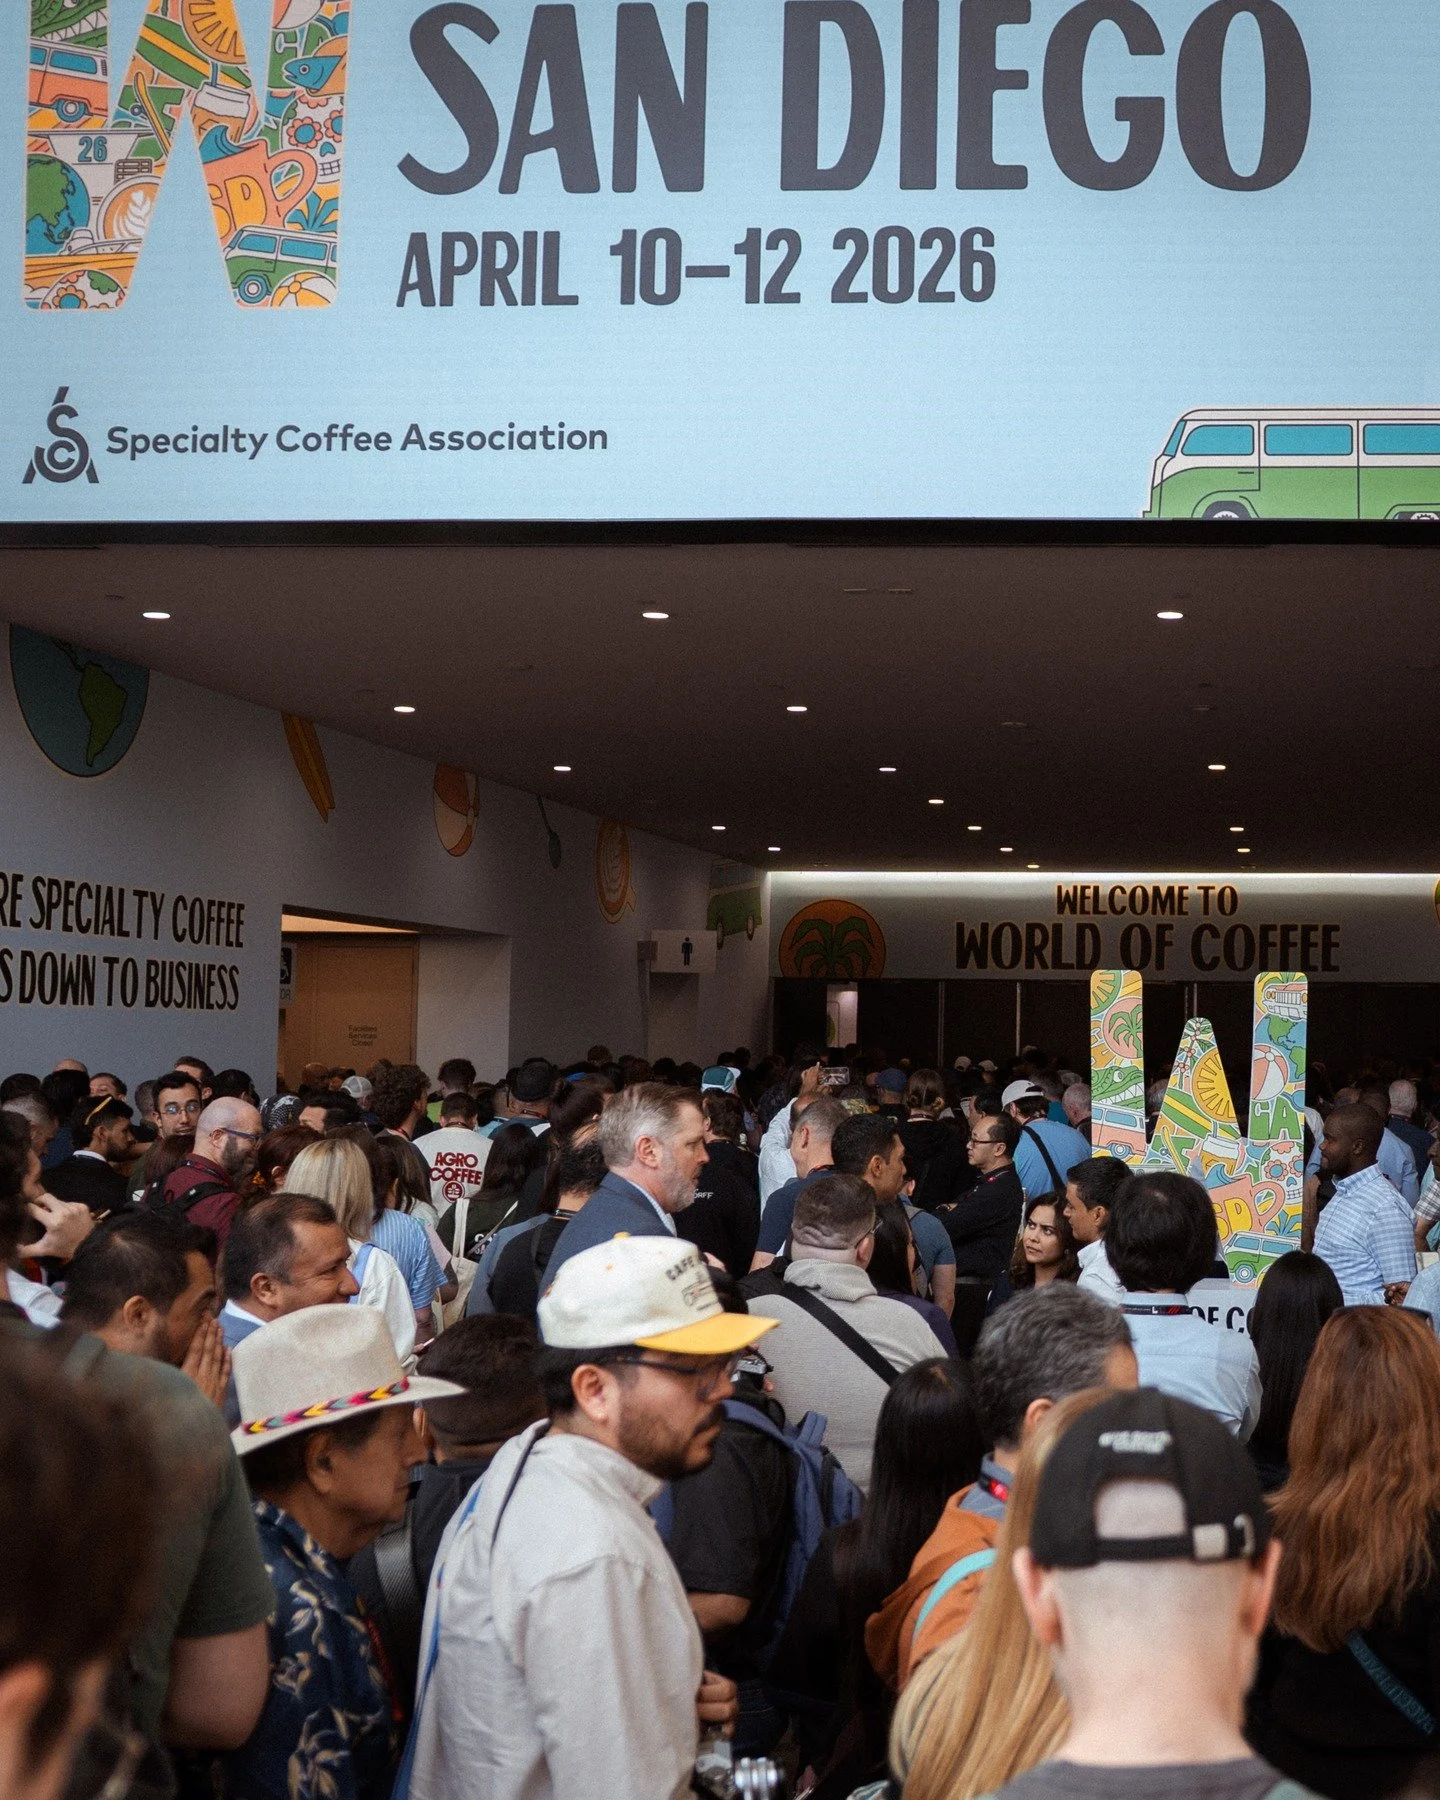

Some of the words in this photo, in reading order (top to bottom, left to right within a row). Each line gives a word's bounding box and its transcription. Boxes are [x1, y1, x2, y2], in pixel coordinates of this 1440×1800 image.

[397, 1, 708, 195] SAN
[780, 0, 1312, 192] DIEGO
[78, 136, 107, 162] 26
[396, 230, 579, 307] APRIL
[831, 225, 996, 306] 2026
[106, 425, 268, 460] Specialty
[276, 424, 392, 452] Coffee
[401, 421, 608, 451] Association
[29, 876, 165, 940] SPECIALTY
[172, 895, 245, 948] COFFEE
[1056, 884, 1189, 916] WELCOME
[1197, 885, 1238, 916] TO
[955, 921, 1100, 970] WORLD
[1119, 922, 1174, 971] OF
[1191, 922, 1340, 972] COFFEE
[19, 950, 96, 1005] DOWN
[103, 956, 138, 1007] TO
[145, 960, 239, 1010] BUSINESS
[430, 1167, 483, 1185] COFFEE
[434, 1152, 478, 1168] AGRO
